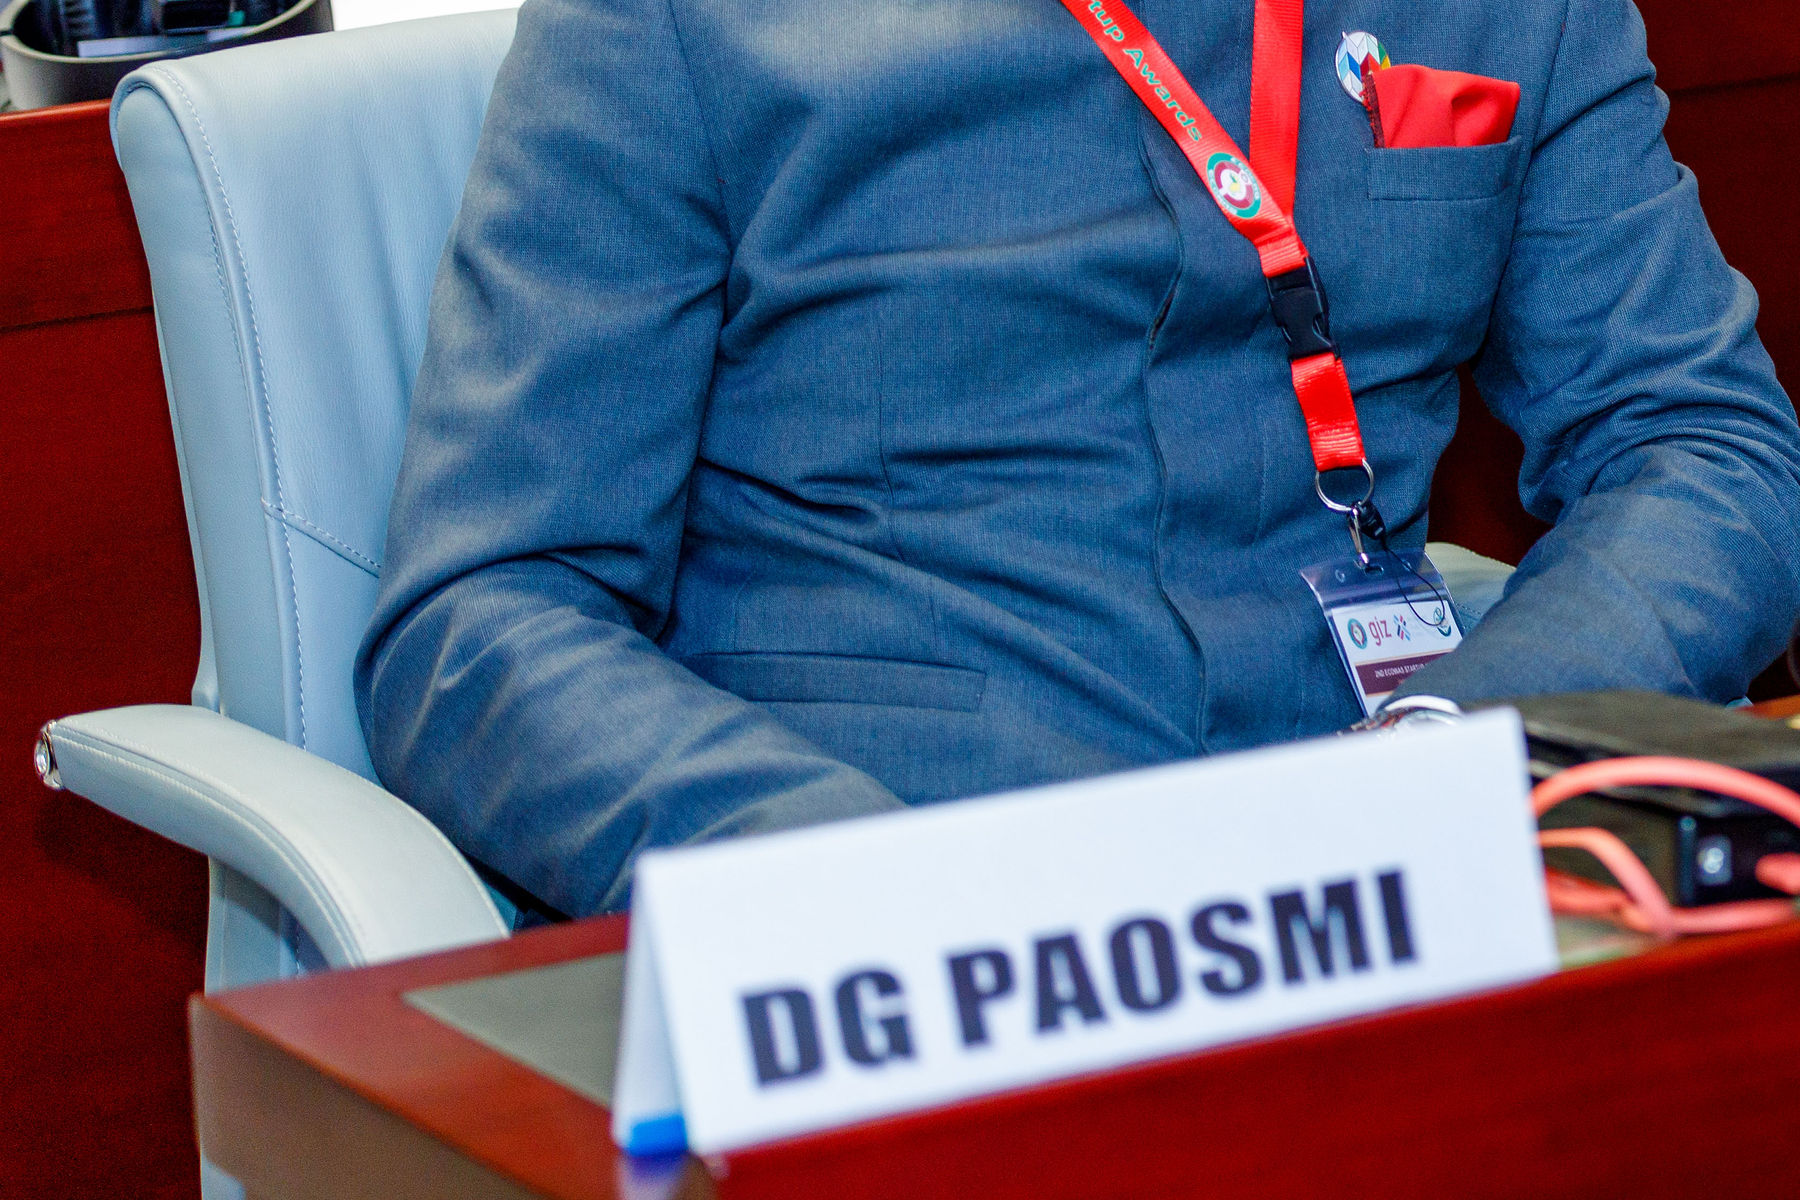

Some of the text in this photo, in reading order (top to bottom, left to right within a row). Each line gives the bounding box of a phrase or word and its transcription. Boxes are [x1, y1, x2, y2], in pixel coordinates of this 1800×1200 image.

[1122, 48, 1203, 142] Awards
[1368, 616, 1393, 647] giz
[741, 869, 1418, 1088] DG PAOSMI
